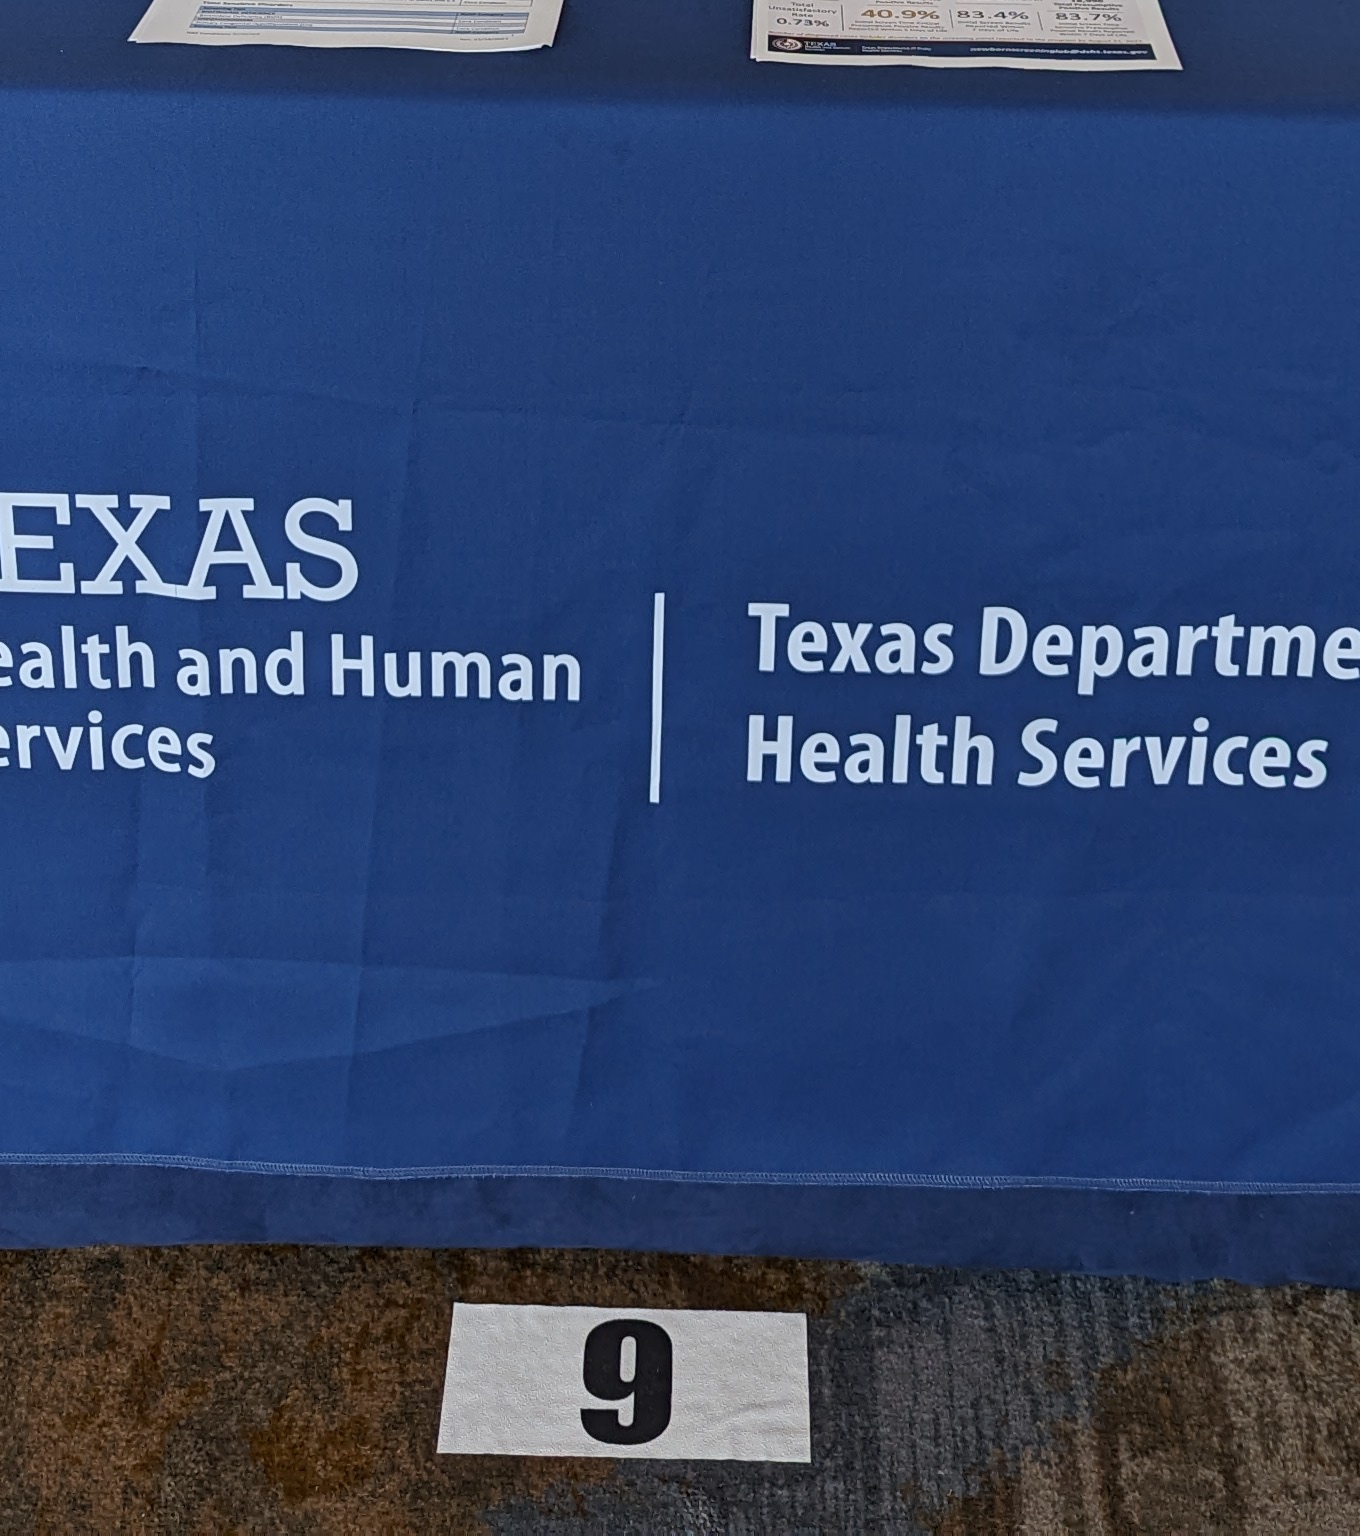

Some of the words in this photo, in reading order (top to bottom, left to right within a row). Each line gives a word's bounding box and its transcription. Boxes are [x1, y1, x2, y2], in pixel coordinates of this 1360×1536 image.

[777, 18, 829, 27] 0.73%
[861, 9, 940, 19] 40.9%
[957, 10, 1029, 20] 83.4%
[1055, 13, 1122, 21] 83.7%
[747, 602, 955, 675] Texas
[176, 630, 306, 697] and
[331, 634, 582, 703] Human
[746, 714, 995, 786] Health
[1017, 717, 1329, 790] Services
[580, 1319, 672, 1445] 9
